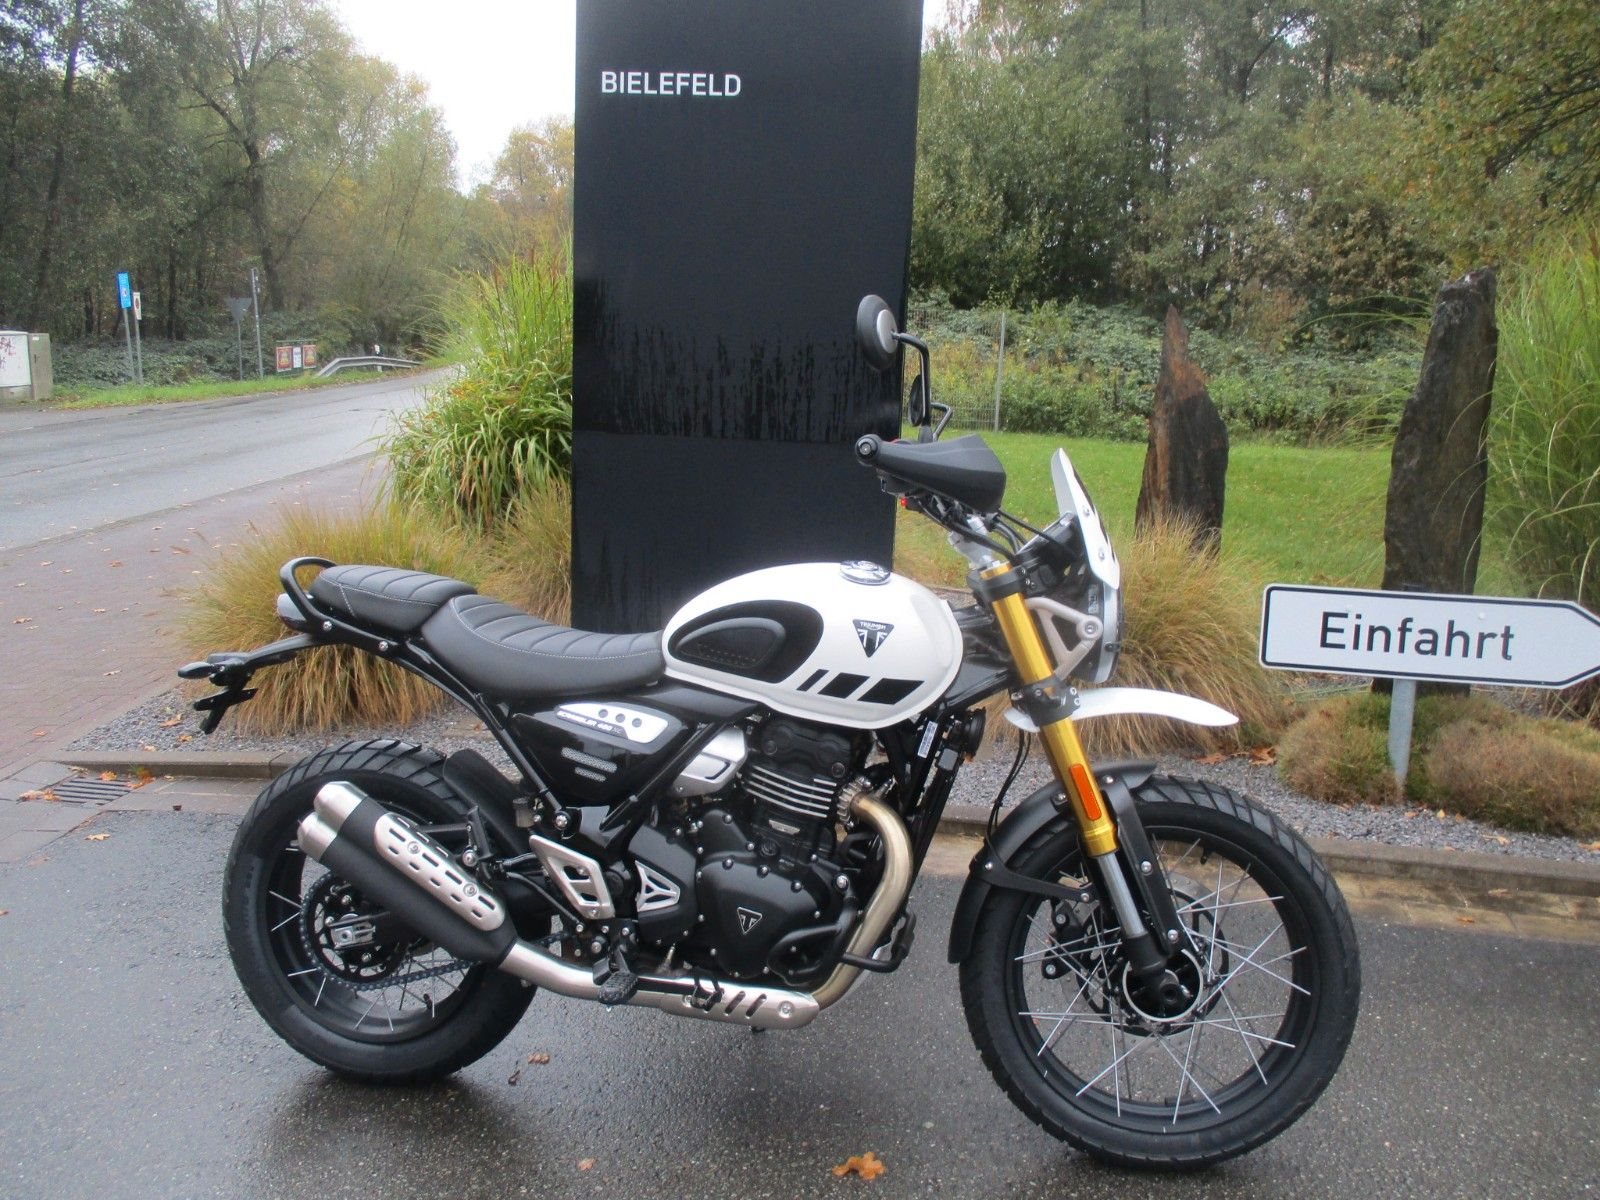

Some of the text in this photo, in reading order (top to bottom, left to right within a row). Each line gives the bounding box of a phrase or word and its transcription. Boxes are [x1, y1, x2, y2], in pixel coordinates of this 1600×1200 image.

[601, 71, 741, 97] BIELEFELD
[860, 621, 887, 631] TRIUMPH
[1319, 611, 1514, 661] Einfahrt
